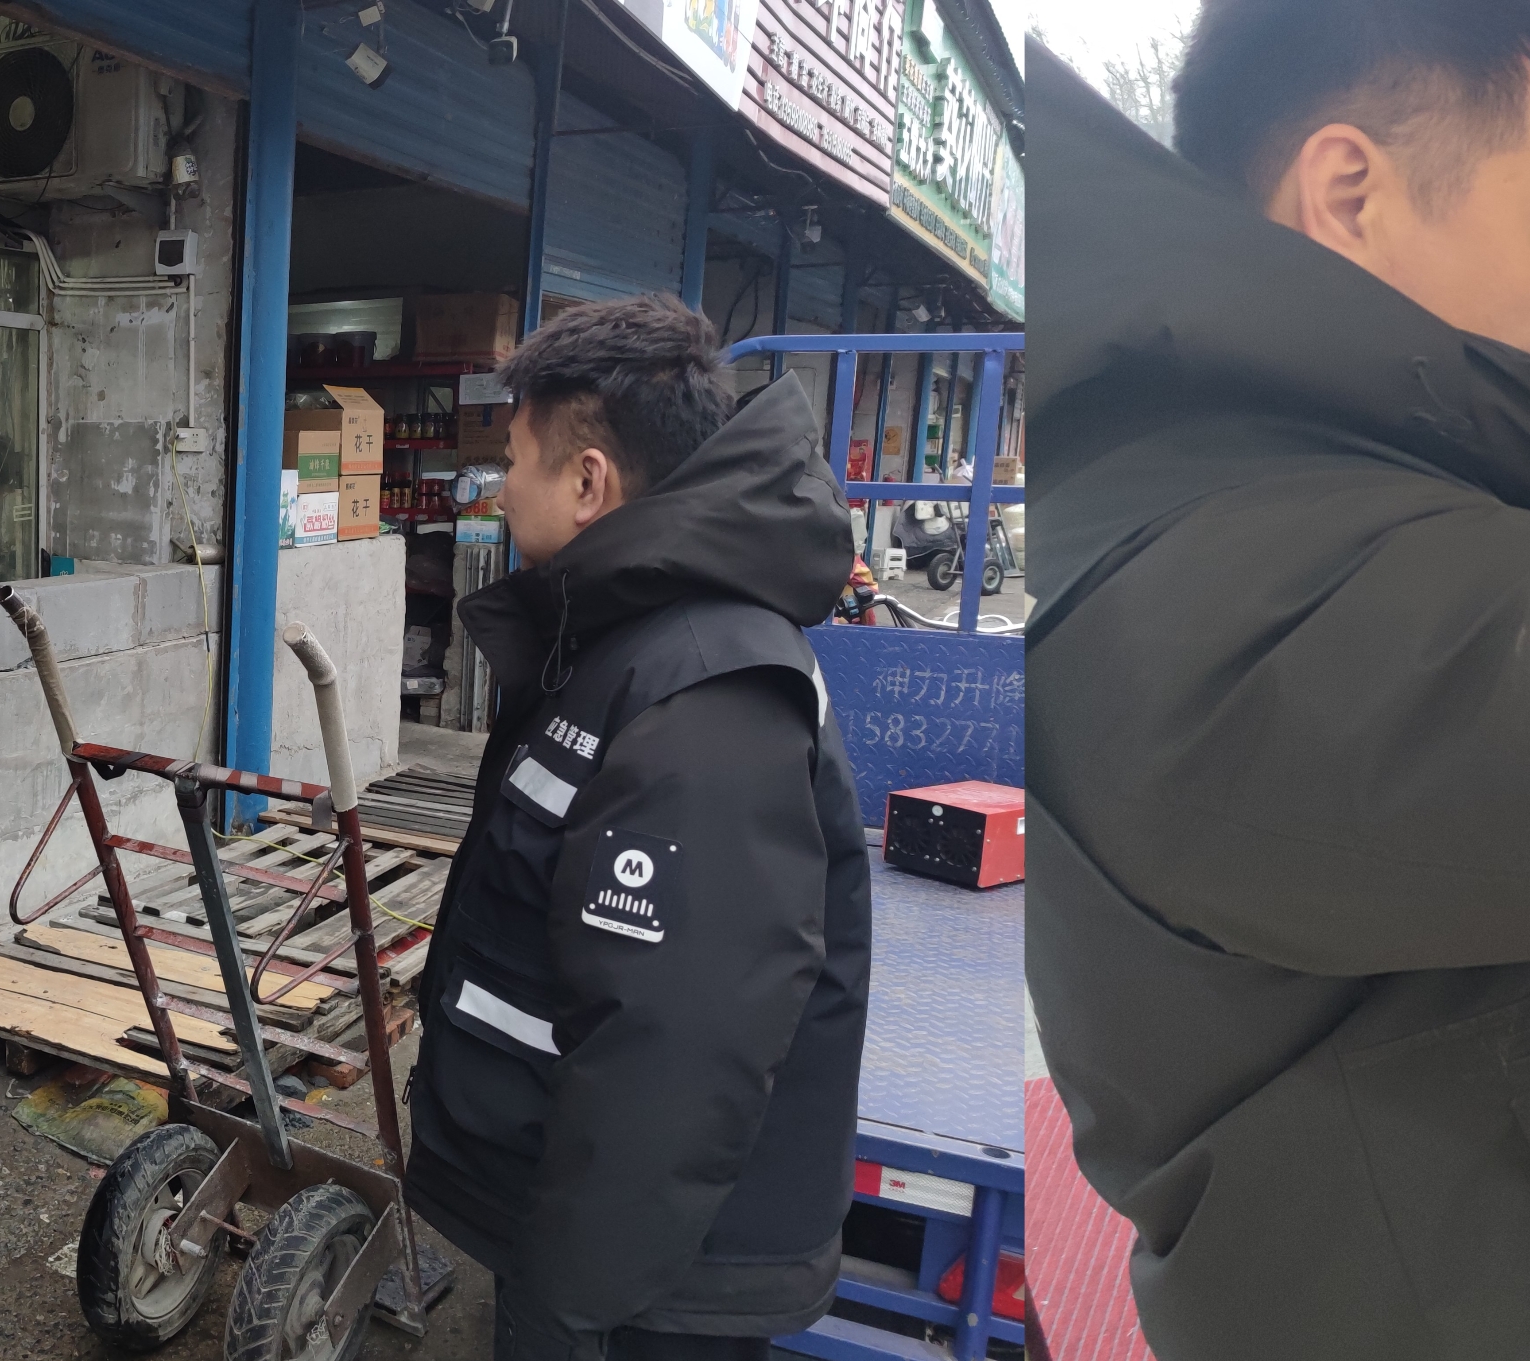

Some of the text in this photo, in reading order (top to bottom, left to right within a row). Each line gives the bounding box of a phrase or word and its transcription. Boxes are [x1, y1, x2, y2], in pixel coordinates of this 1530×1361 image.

[353, 433, 375, 454] 花干
[351, 498, 371, 518] 花干
[544, 713, 601, 762] 应急管理
[621, 858, 645, 879] M
[888, 1178, 907, 1191] 3M
